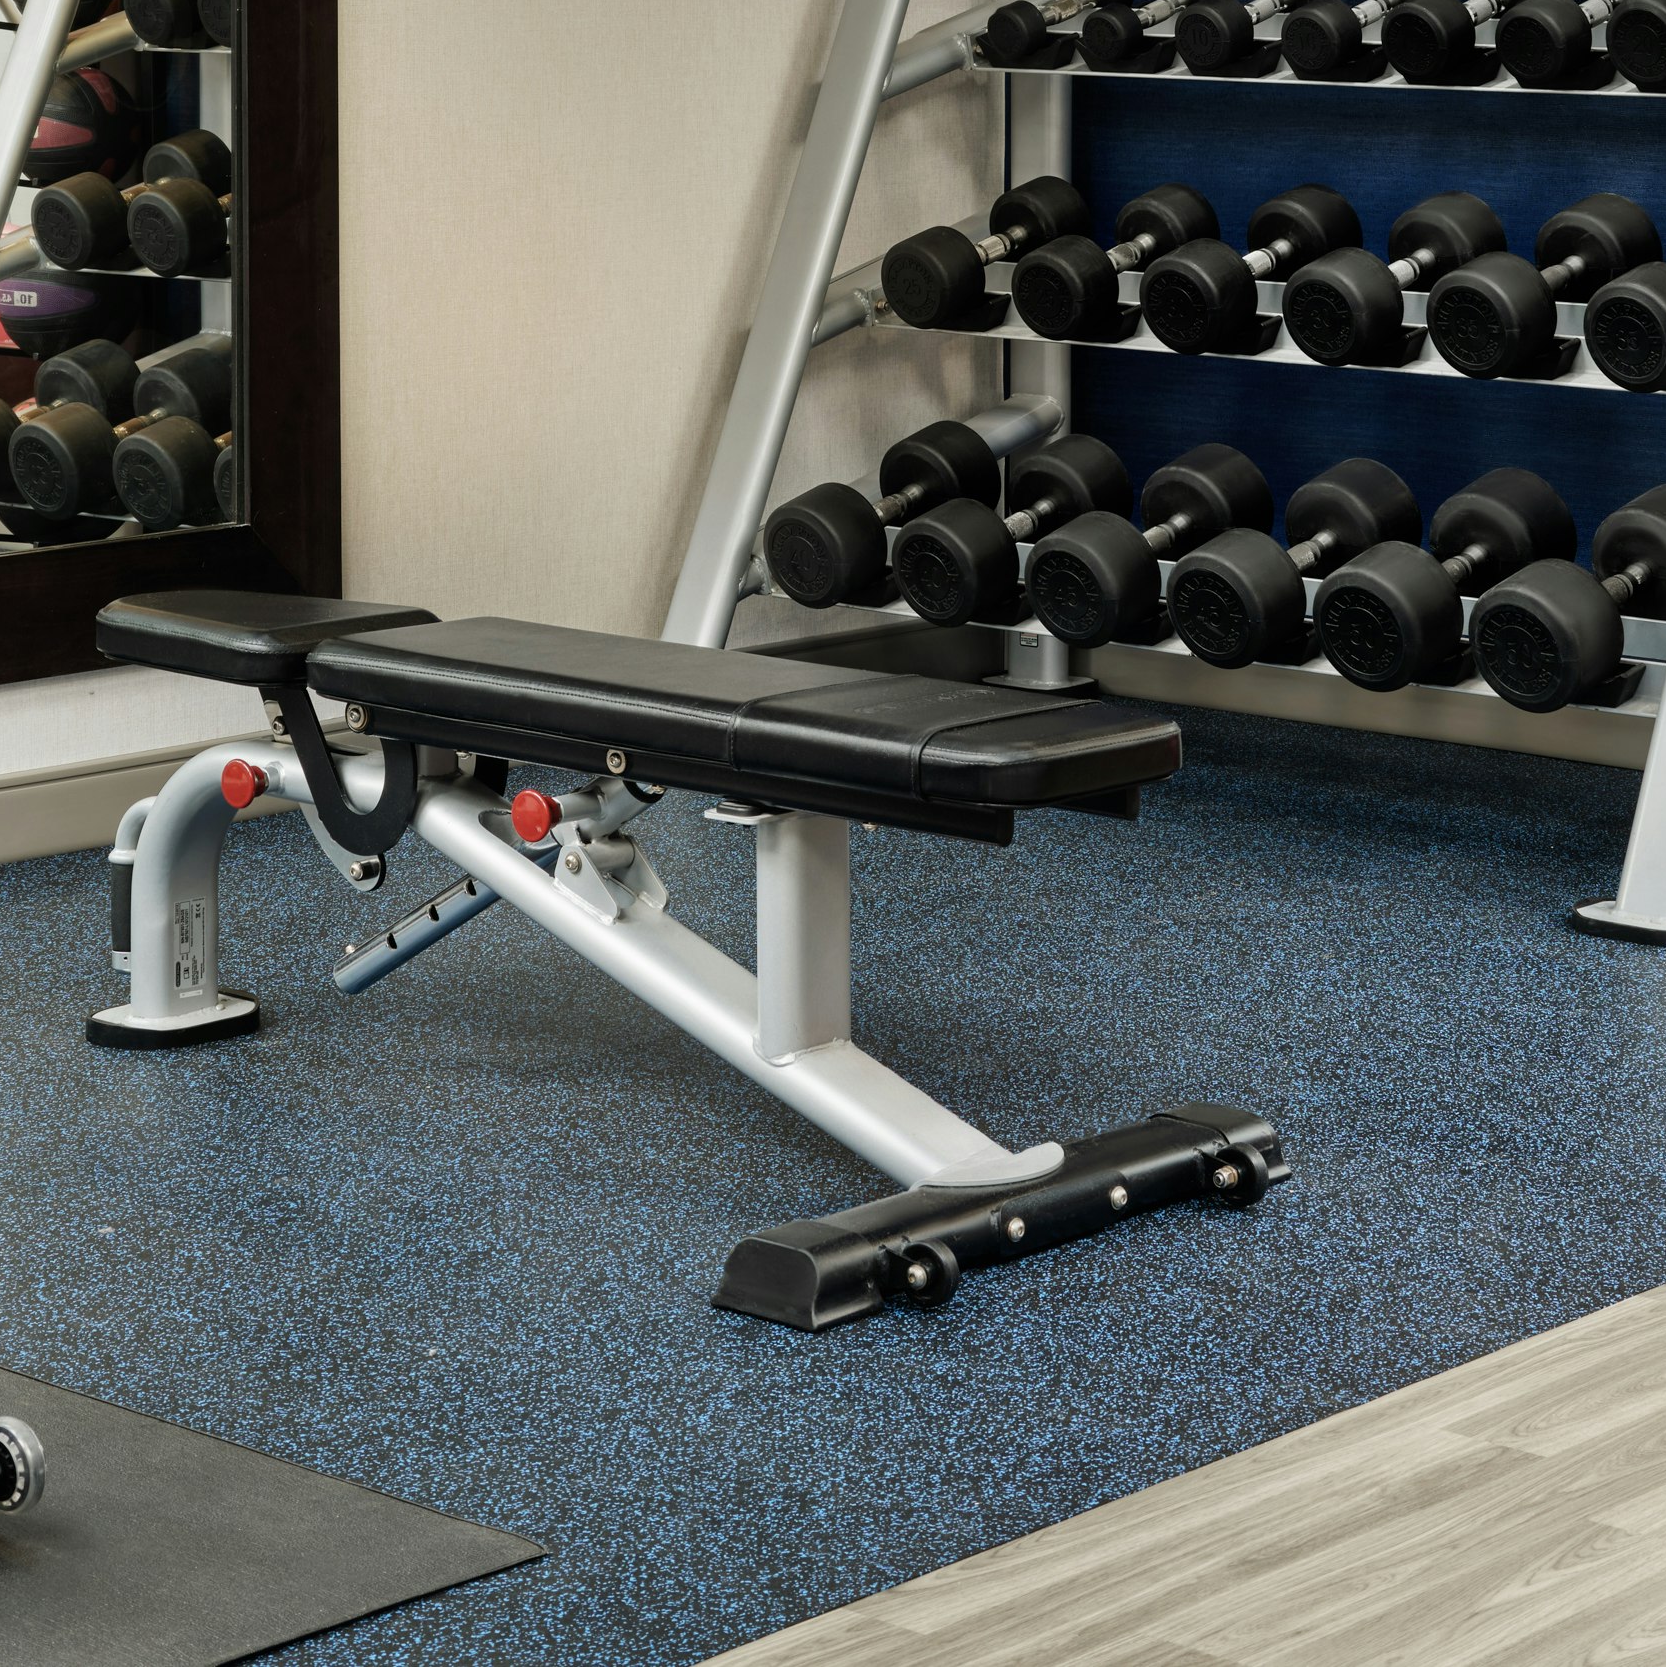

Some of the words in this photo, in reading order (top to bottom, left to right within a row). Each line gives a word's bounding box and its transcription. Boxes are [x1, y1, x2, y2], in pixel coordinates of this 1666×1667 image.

[902, 277, 922, 296] 25
[1437, 292, 1500, 327] HAMPTON
[1456, 316, 1480, 339] 35
[1596, 303, 1661, 338] HAMPTON
[901, 540, 960, 576] HAMPTON
[1036, 558, 1100, 597] HAMPTON
[1176, 576, 1244, 617] HAMPTON
[1325, 594, 1398, 637] HAMPTON
[1481, 612, 1556, 656] HAMPTON
